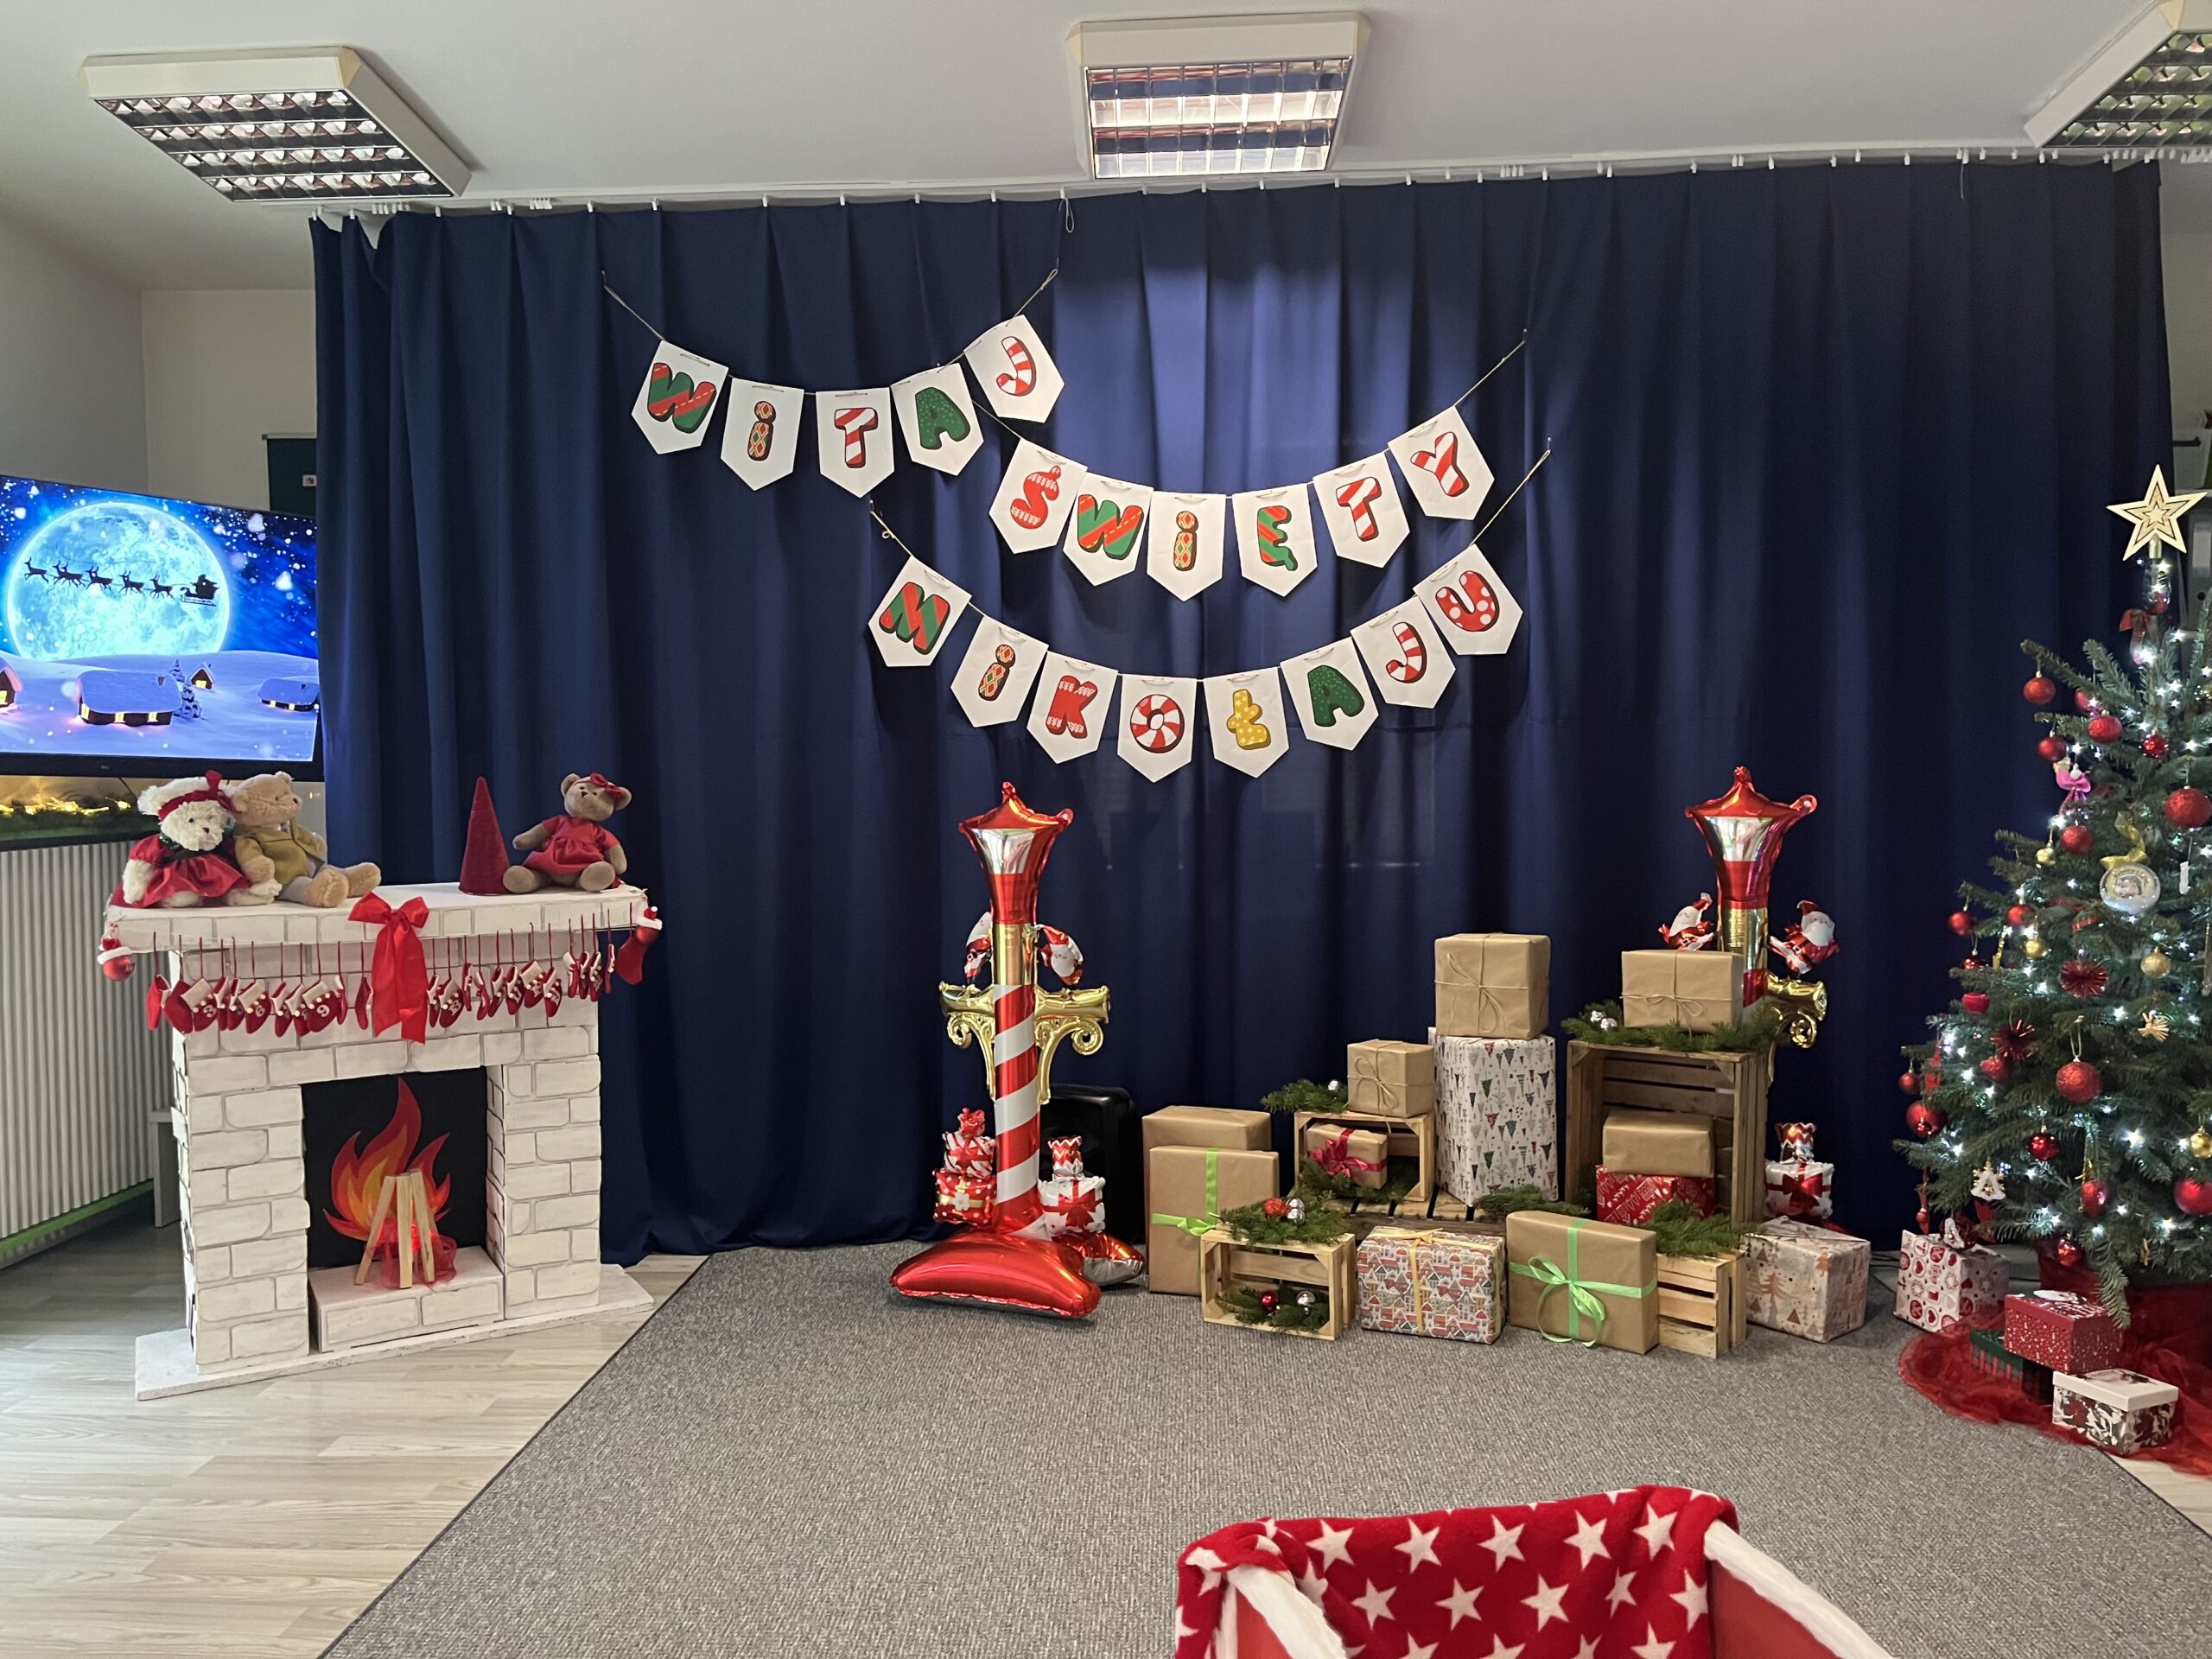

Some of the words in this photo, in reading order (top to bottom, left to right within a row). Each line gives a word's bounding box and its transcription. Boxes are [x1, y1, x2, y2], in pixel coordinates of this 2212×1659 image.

[203, 1004, 218, 1018] 3
[255, 1003, 265, 1018] 6
[316, 1004, 330, 1018] 9
